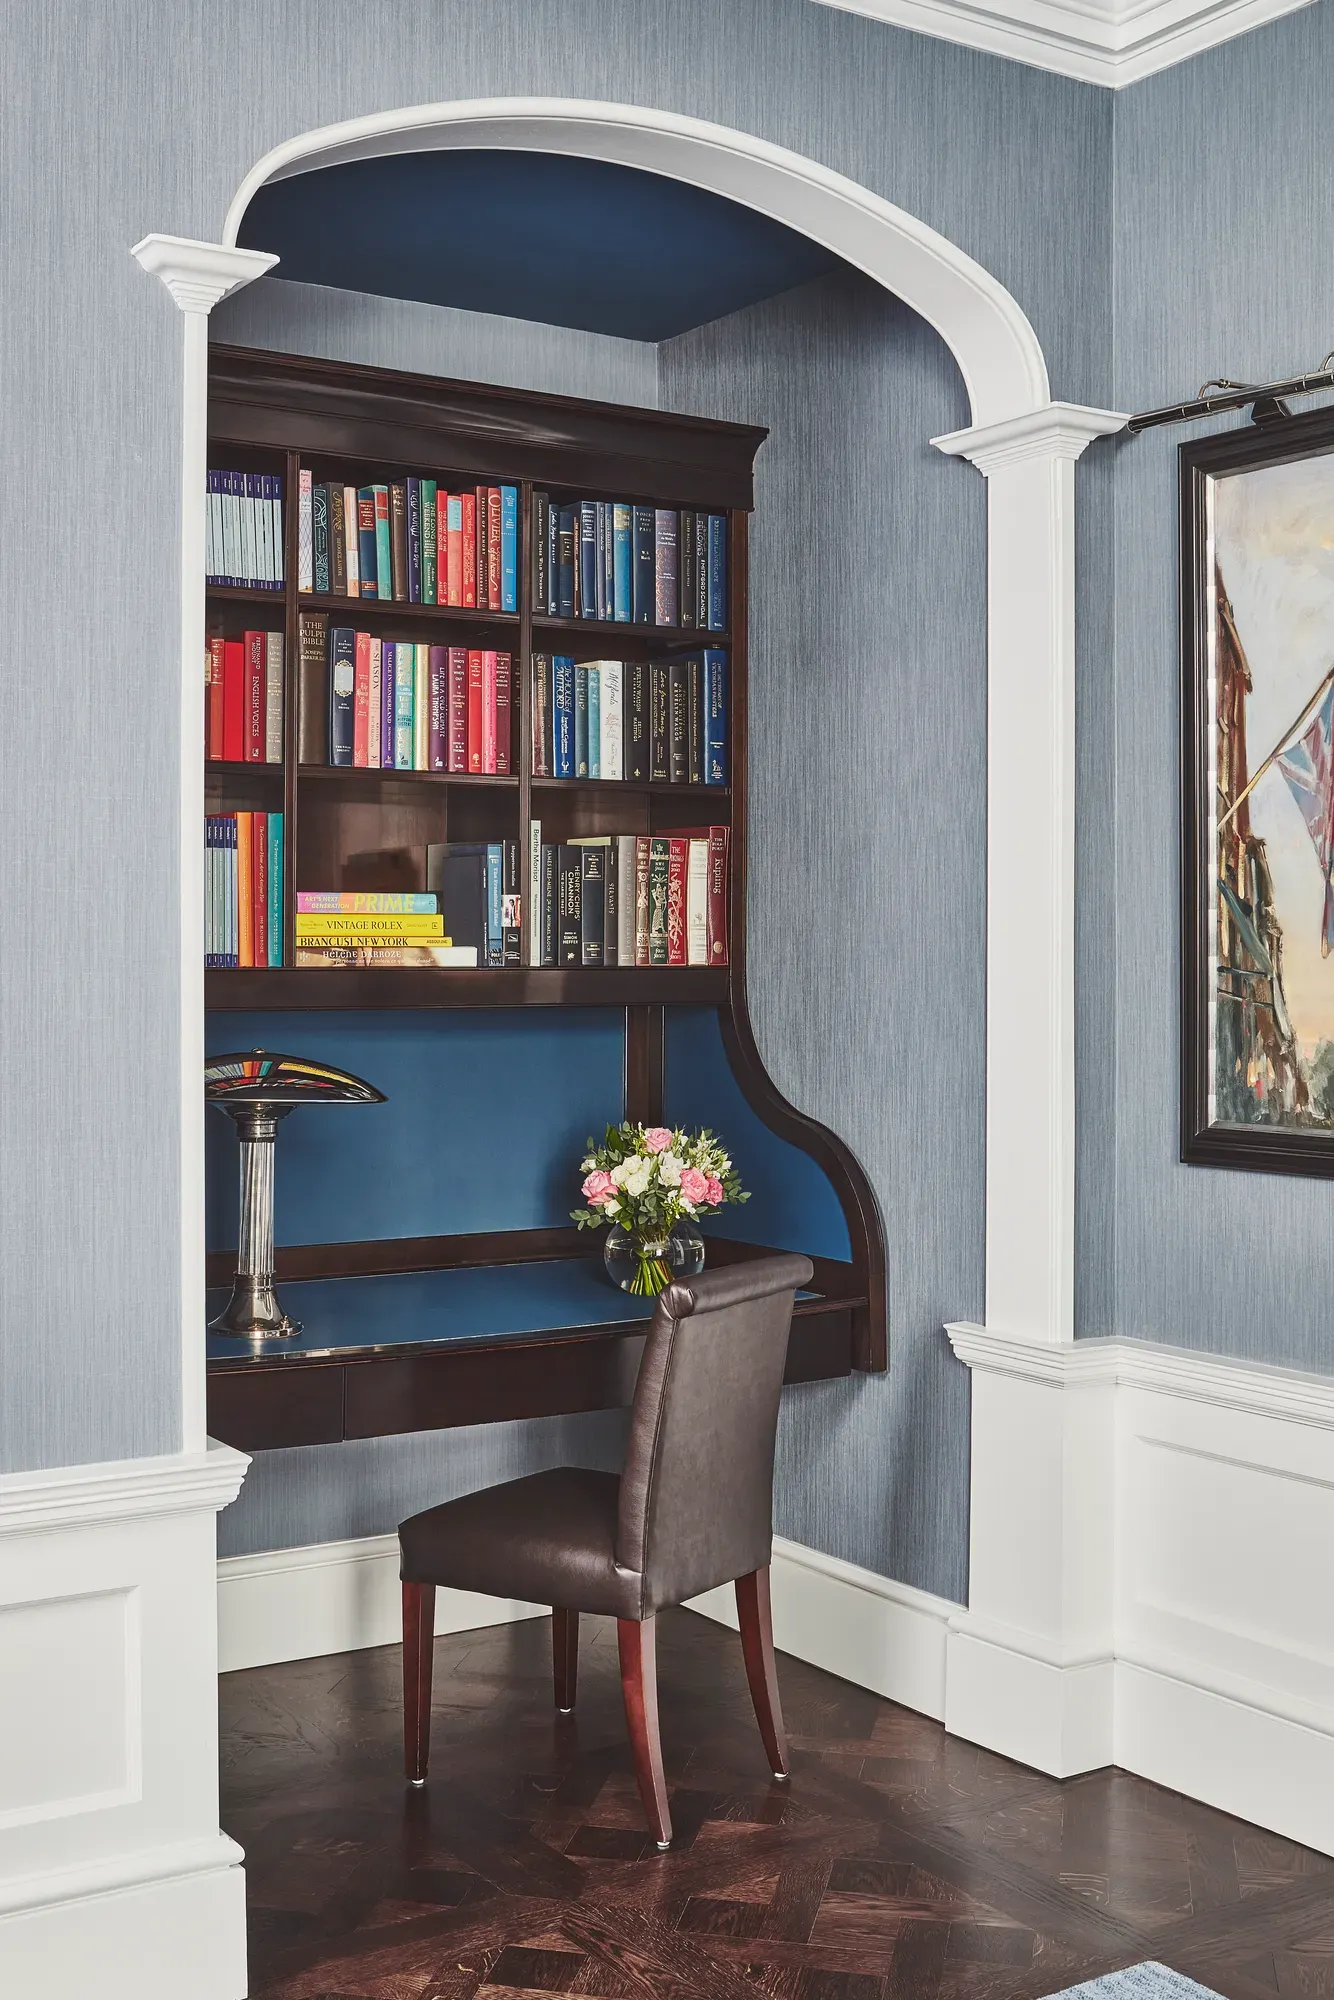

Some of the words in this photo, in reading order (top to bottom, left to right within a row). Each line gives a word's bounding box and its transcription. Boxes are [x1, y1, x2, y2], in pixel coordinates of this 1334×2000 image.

[488, 494, 501, 544] OLIVIER
[300, 629, 326, 638] PULPIT
[303, 638, 324, 646] BIBLE
[658, 690, 666, 710] from
[713, 858, 724, 894] Kipling
[354, 894, 415, 912] PRIME
[326, 920, 369, 930] VINTAGE
[371, 920, 403, 930] ROLEX
[300, 938, 354, 946] BRANCUSI
[357, 938, 381, 946] NEW
[381, 938, 408, 946] YORK
